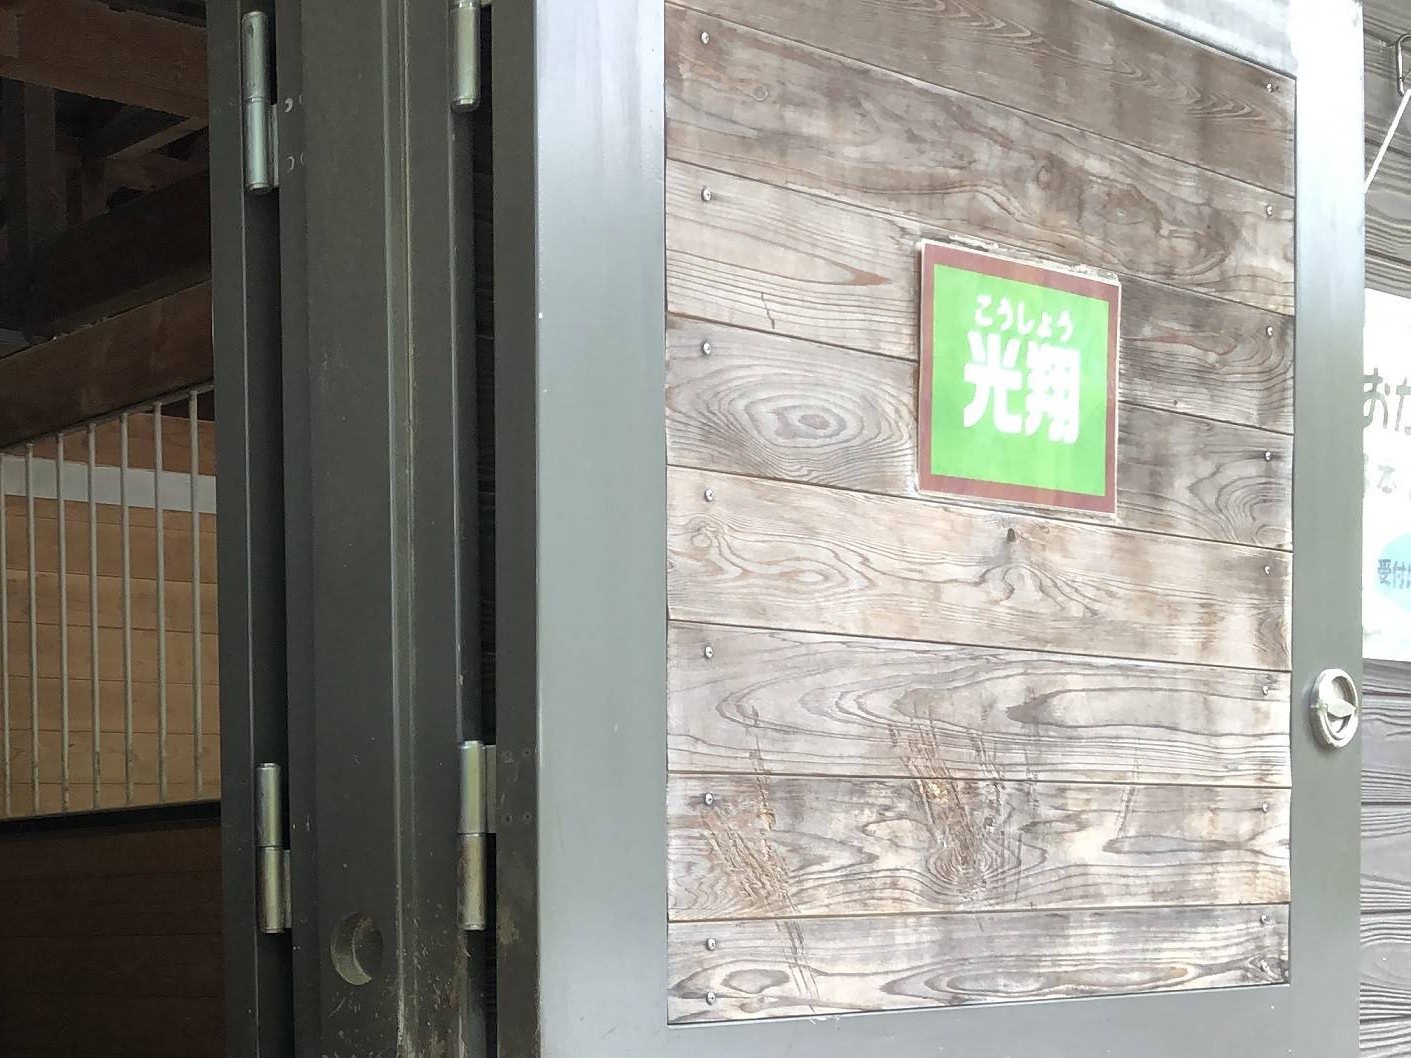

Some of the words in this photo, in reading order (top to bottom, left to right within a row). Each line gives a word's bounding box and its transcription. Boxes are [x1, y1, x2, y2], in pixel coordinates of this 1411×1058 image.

[975, 294, 1074, 342] こうしょう
[963, 330, 1081, 444] 光翔
